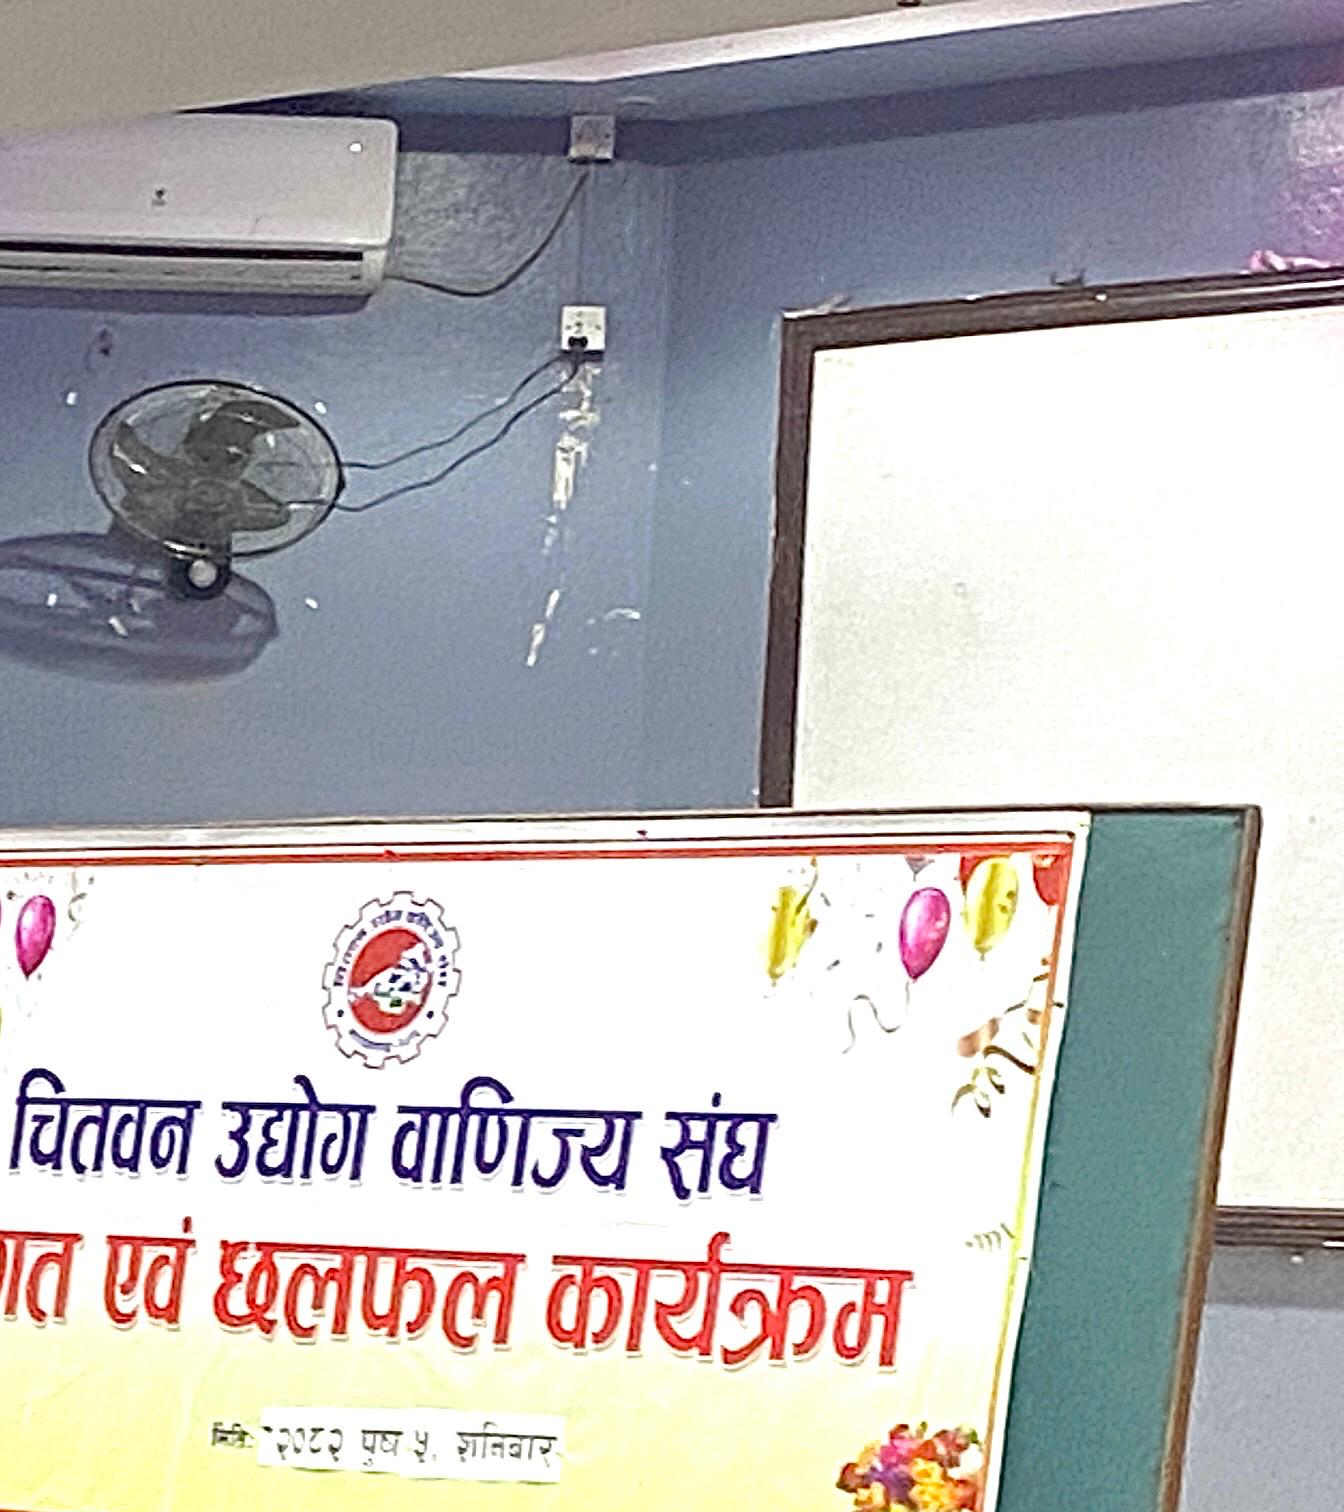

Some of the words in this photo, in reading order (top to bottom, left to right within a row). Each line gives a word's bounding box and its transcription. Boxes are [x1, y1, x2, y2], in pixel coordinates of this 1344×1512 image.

[9, 1068, 202, 1175] चितवन
[214, 1074, 377, 1180] उद्योग
[391, 1076, 643, 1191] वाणिज्य
[659, 1092, 779, 1200] संघ
[103, 1215, 197, 1325] एवं
[212, 1239, 527, 1349] छलफल
[544, 1230, 915, 1367] कार्यक्रम
